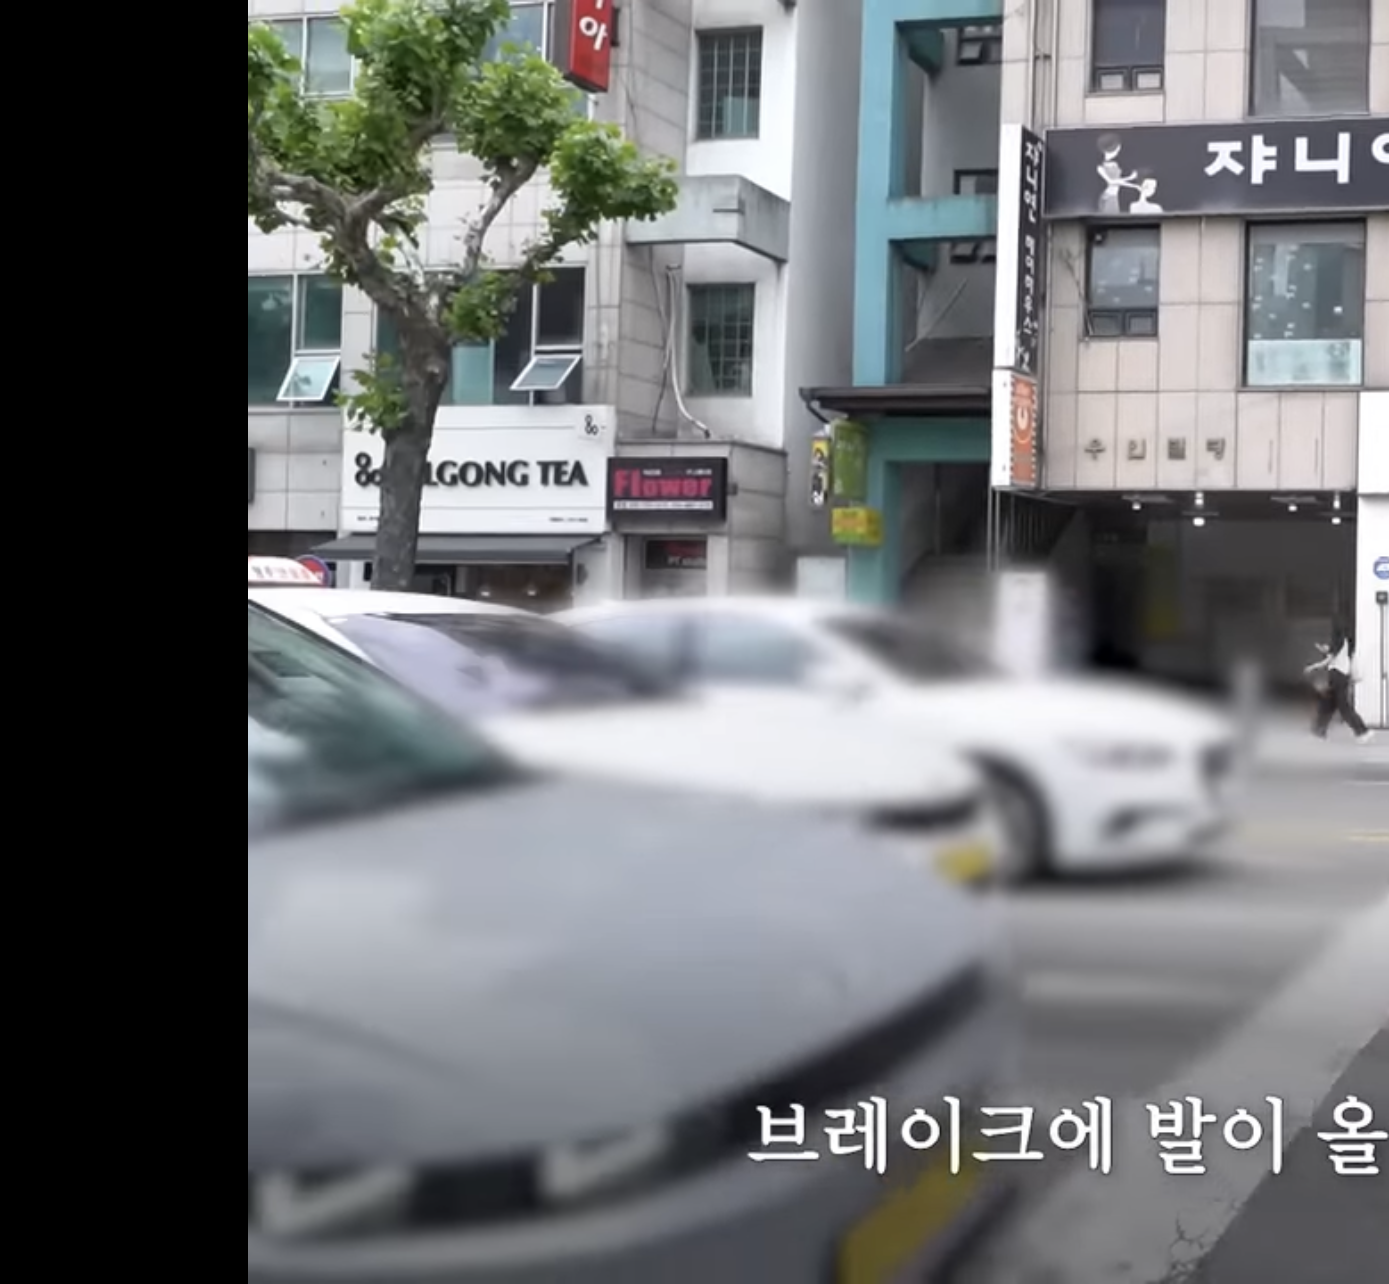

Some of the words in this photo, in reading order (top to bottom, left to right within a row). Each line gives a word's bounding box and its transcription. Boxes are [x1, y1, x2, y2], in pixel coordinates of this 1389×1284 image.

[424, 460, 530, 487] LGONG
[536, 460, 589, 486] TEA
[613, 468, 713, 498] Flower
